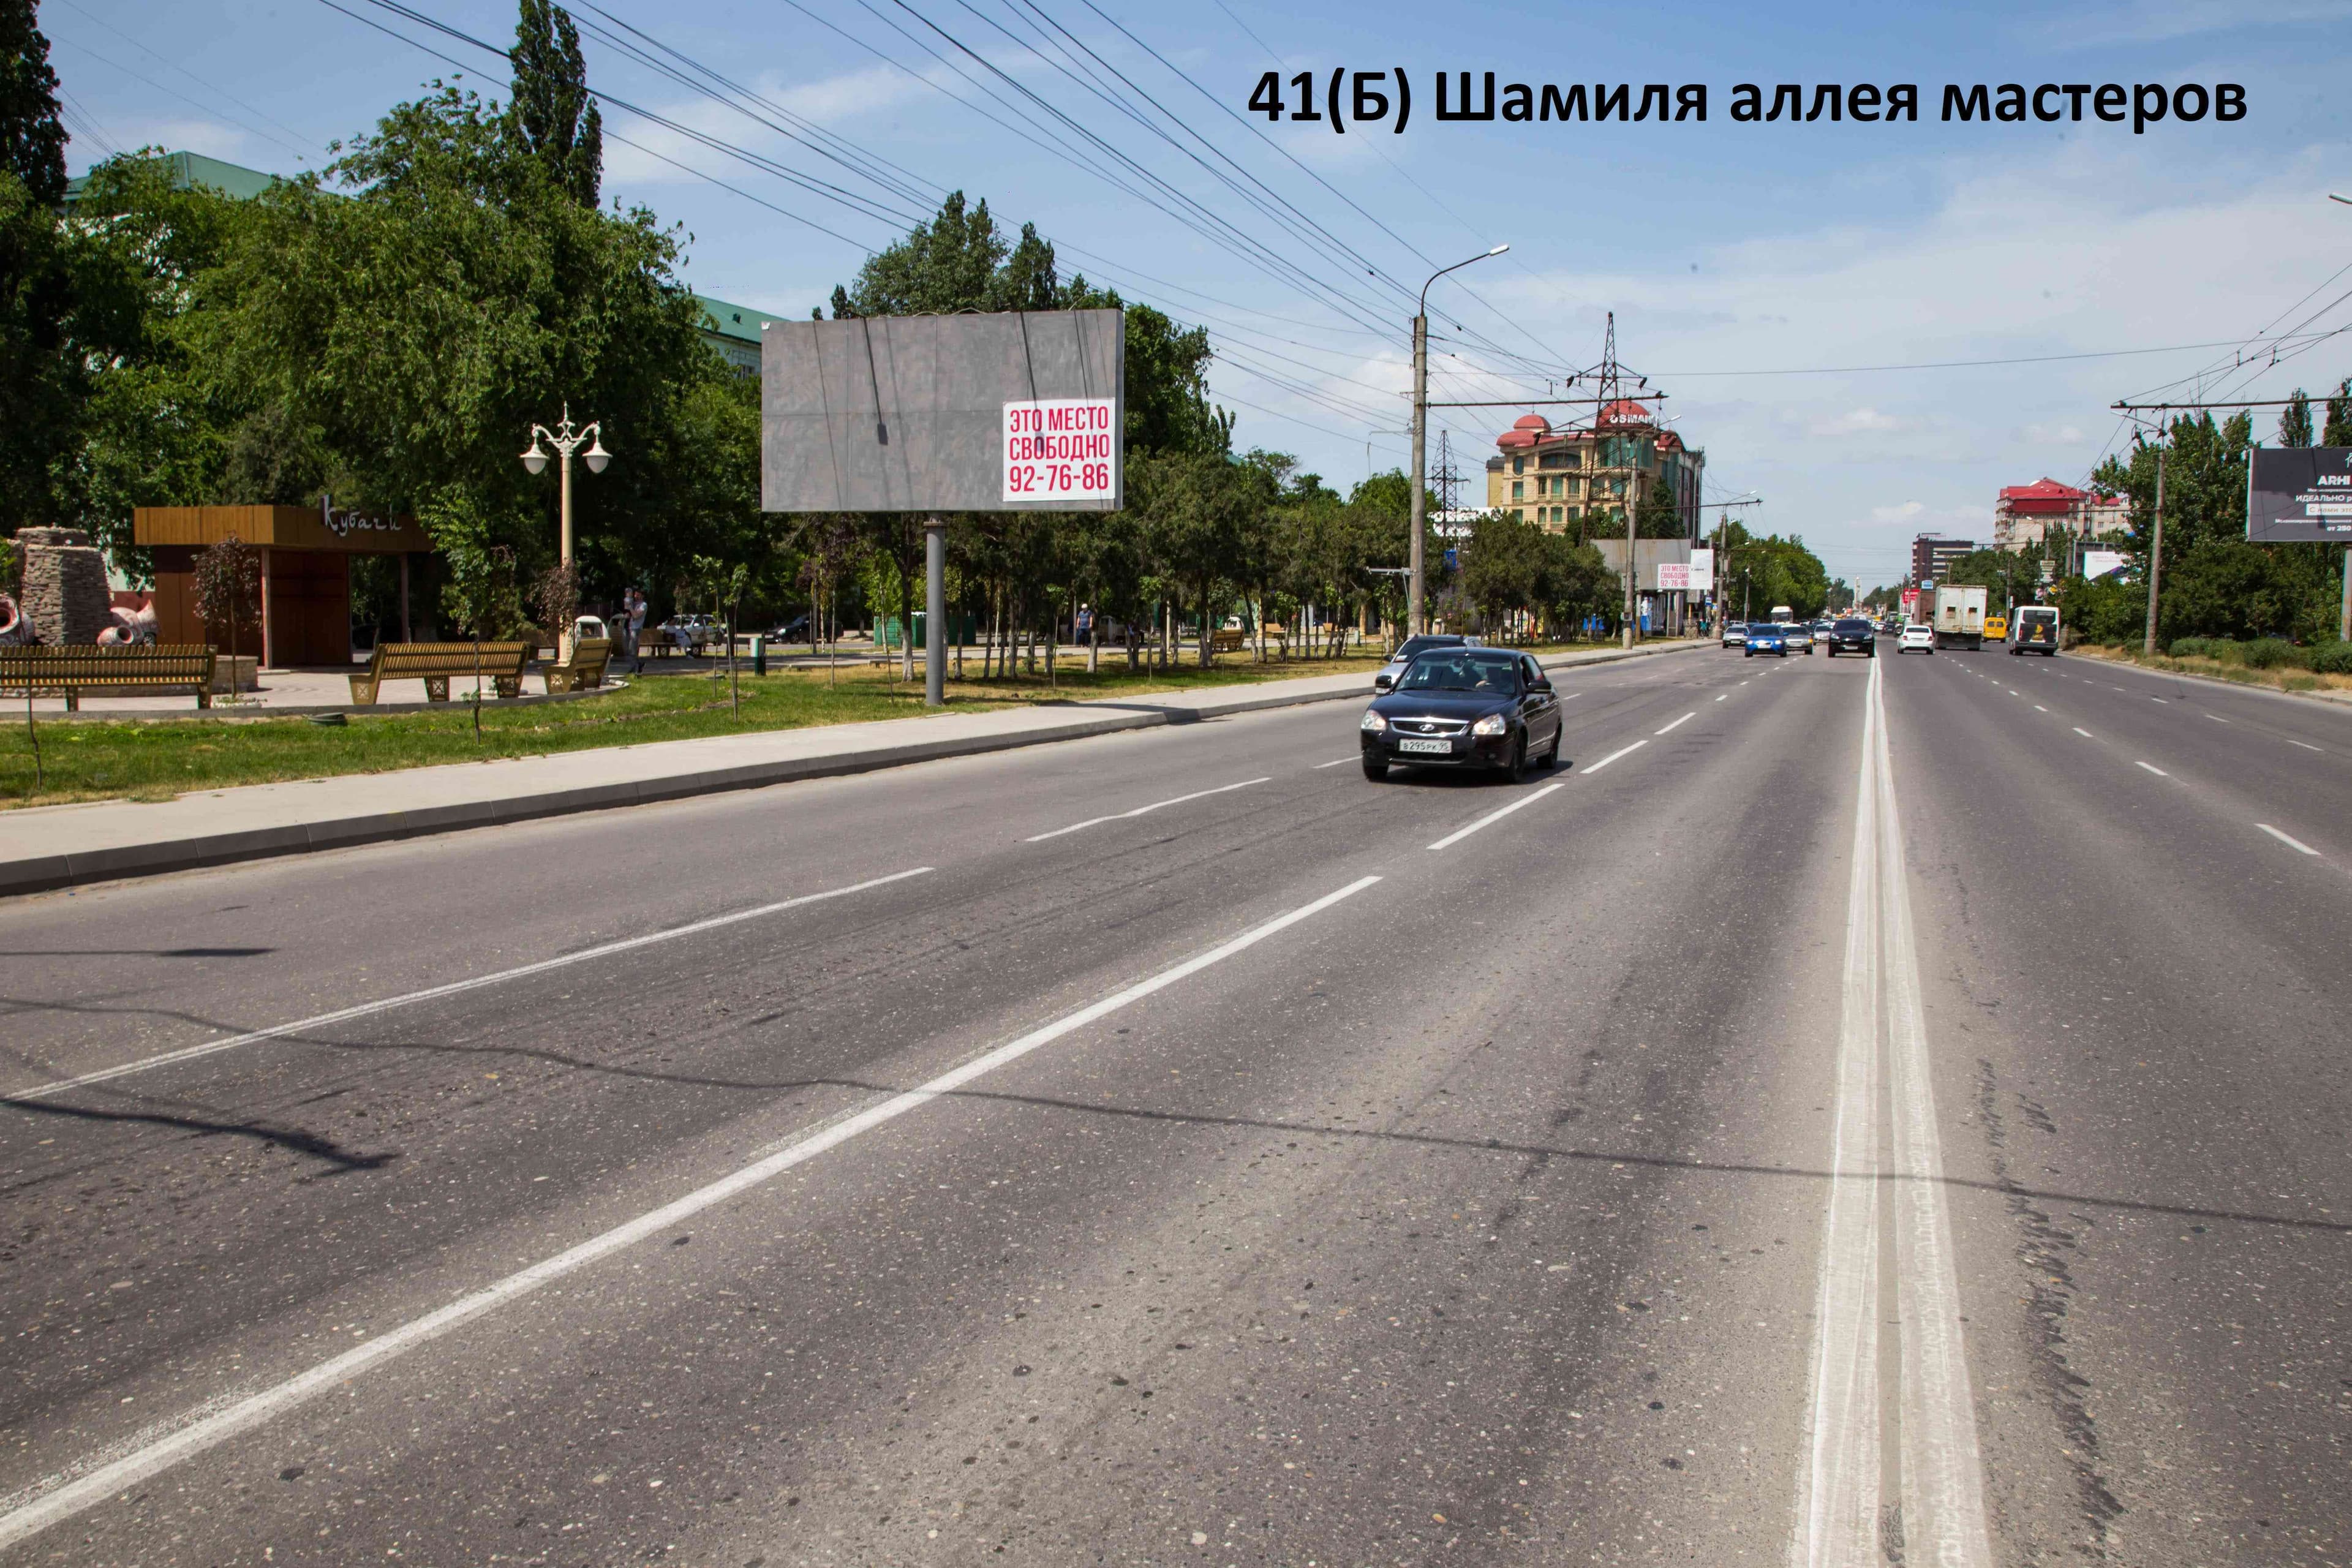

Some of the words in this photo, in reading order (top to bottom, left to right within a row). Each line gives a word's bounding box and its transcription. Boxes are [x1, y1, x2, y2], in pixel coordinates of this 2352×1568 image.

[1010, 409, 1042, 432] ЭТО
[1048, 406, 1109, 431] МЕСТО
[1009, 434, 1110, 462] СВОБОДНО
[1009, 463, 1109, 492] 92-76-86
